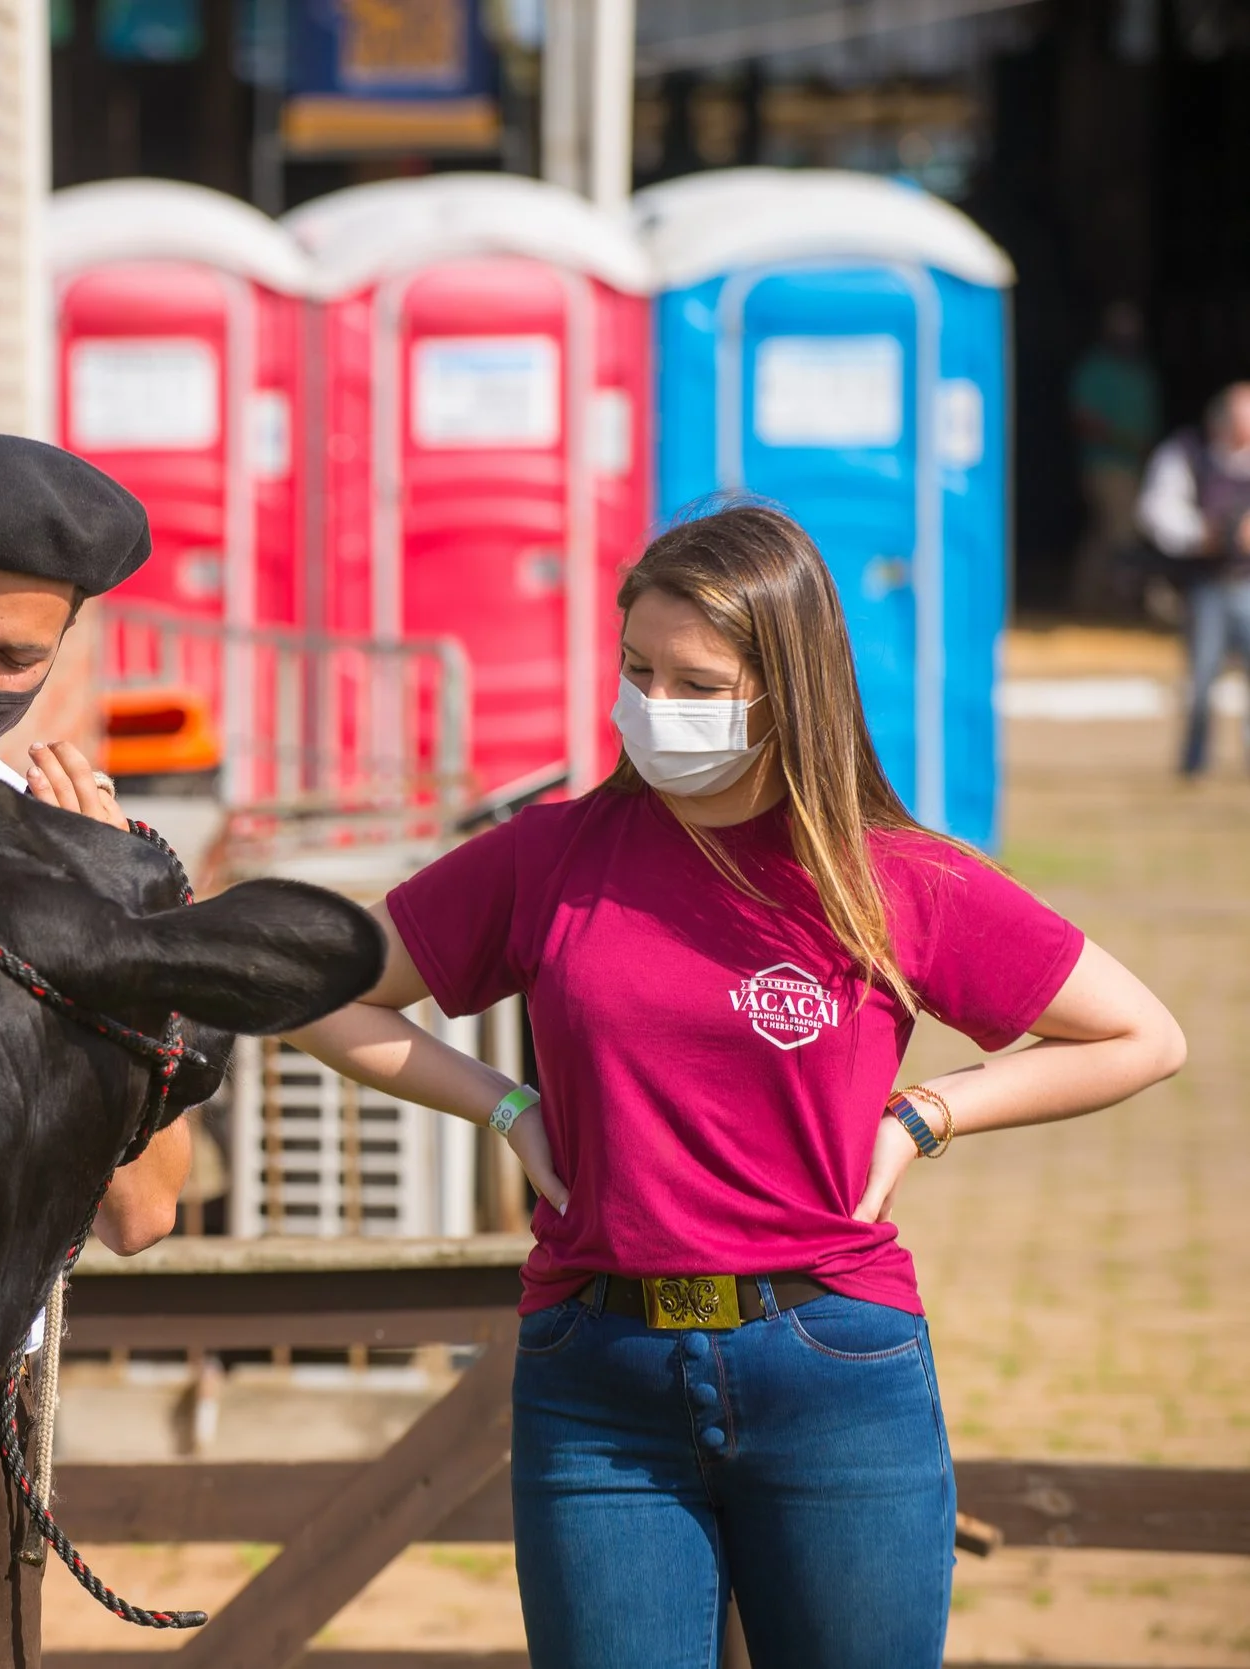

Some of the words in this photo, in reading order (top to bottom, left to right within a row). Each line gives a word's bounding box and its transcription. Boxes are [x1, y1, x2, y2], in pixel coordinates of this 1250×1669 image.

[728, 990, 838, 1027] VACACAÍ
[769, 1022, 809, 1034] HEREFORD
[790, 1016, 823, 1029] BRAFORD
